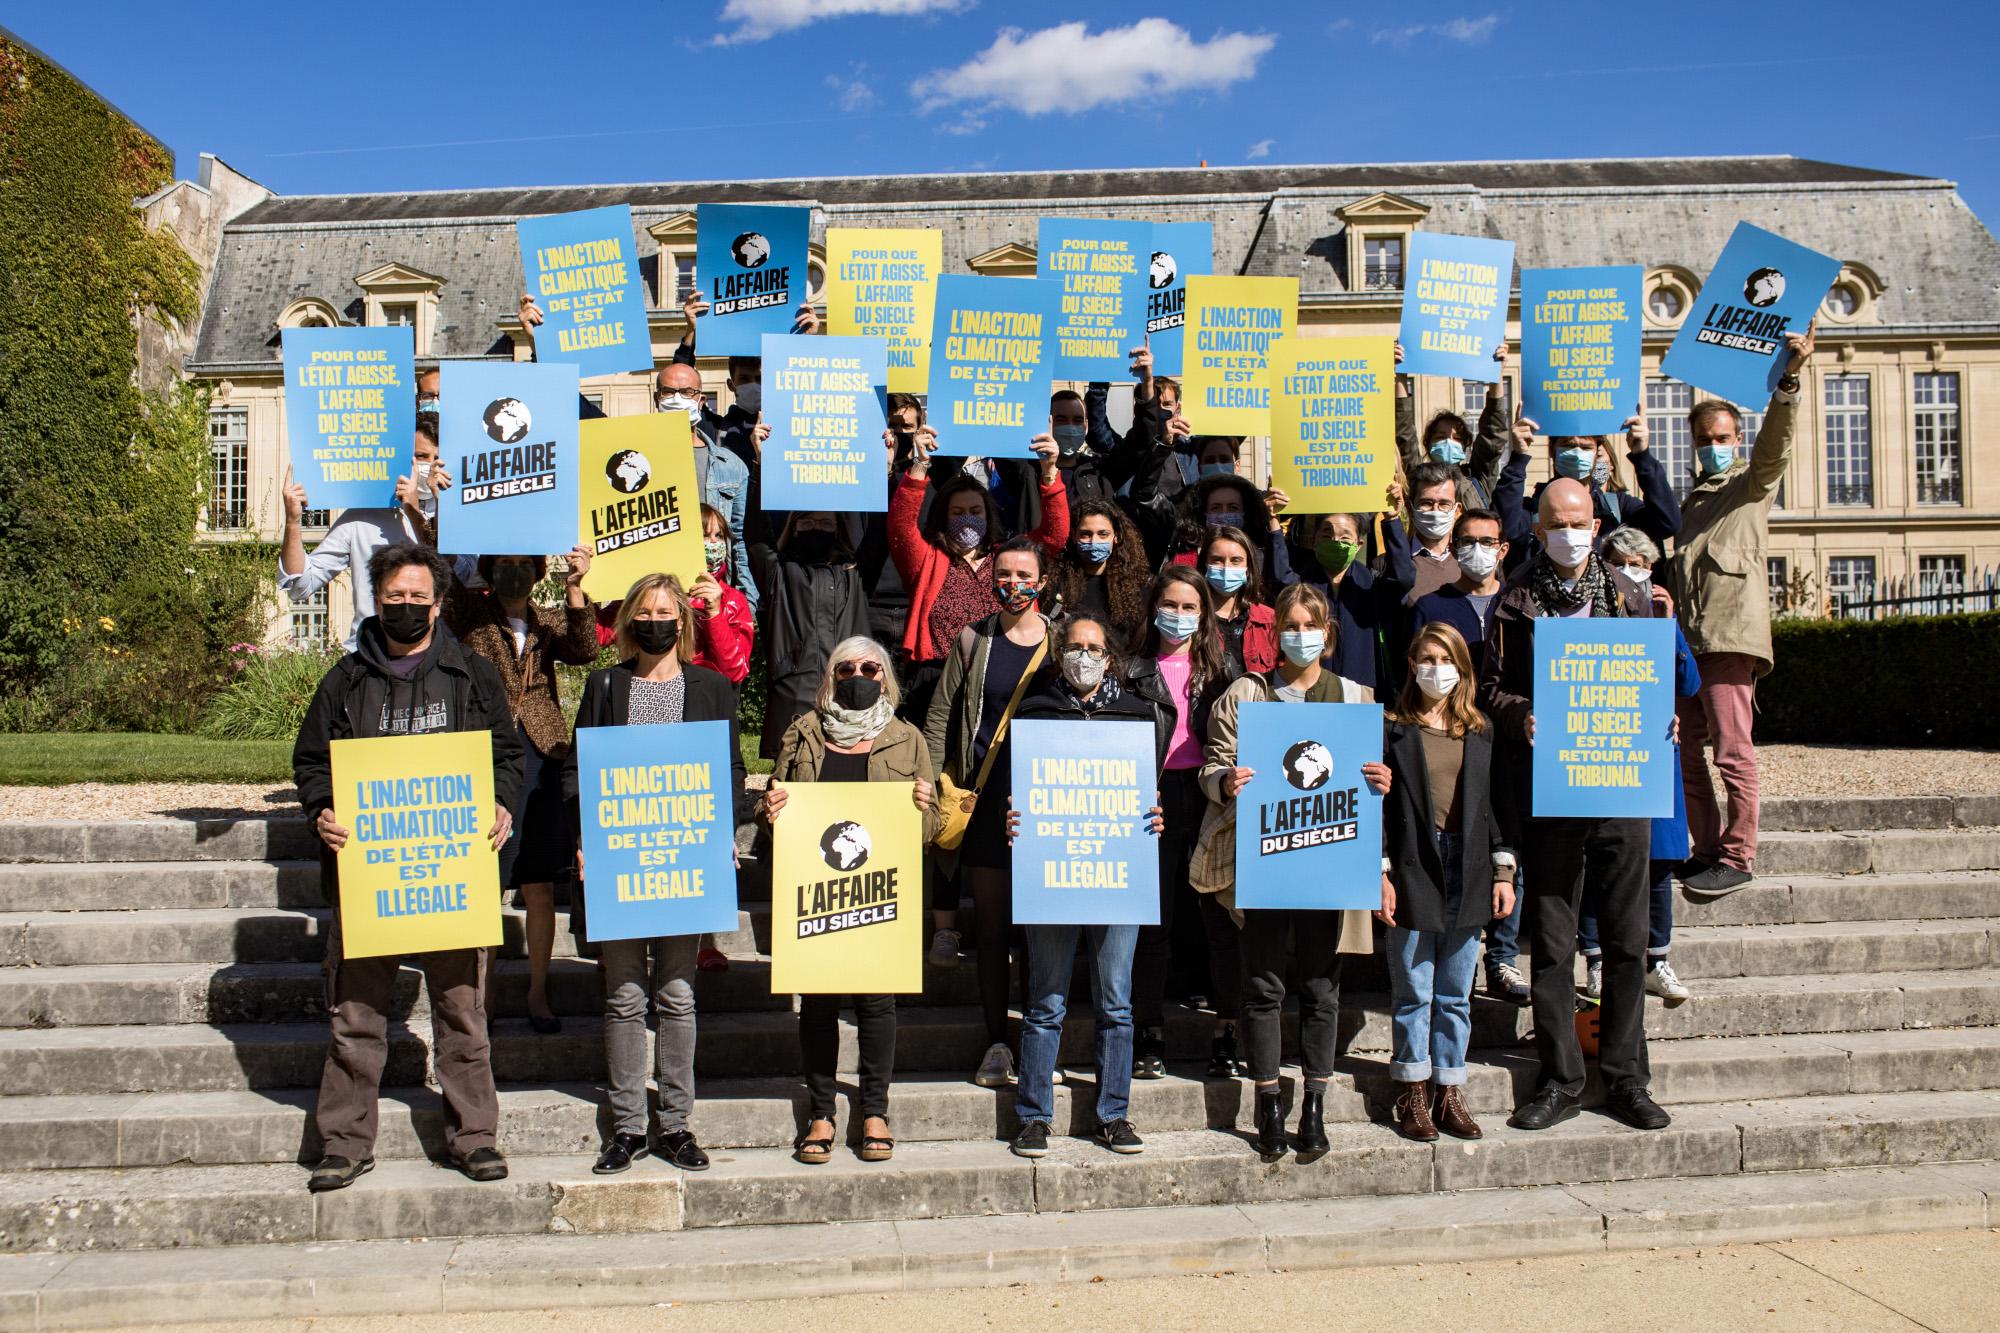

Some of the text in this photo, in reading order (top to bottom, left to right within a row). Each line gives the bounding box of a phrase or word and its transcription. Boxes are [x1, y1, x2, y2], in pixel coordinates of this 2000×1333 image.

[538, 238, 621, 271] L'INACTION
[852, 250, 917, 259] POUR QUE
[1063, 240, 1128, 251] POUR QUE
[841, 261, 928, 282] L'ÉTAT AGISSE,
[1050, 250, 1138, 275] L'ÉTAT AGISSE,
[1422, 259, 1498, 286] L'INACTION
[540, 262, 628, 296] CLIMATIQUE
[714, 266, 789, 300] L'AFFAIRE
[1065, 275, 1122, 293] L'AFFAIRE
[549, 290, 624, 312] DE L'ÉTAT
[716, 293, 786, 314] DU SIÈCLE
[856, 285, 912, 302] L'AFFAIRE
[1062, 293, 1122, 315] DU SIÈCLE
[1417, 280, 1498, 308] CLIMATIQUE
[1548, 288, 1617, 300] POUR QUE
[574, 308, 603, 323] EST
[855, 304, 914, 324] DU SIÈCLE
[1069, 316, 1113, 326] EST DE
[1147, 313, 1184, 332] SIÈCL
[1201, 307, 1281, 328] L'INACTION
[1420, 304, 1490, 320] DE L'ÉTAT
[1535, 301, 1629, 323] L'ÉTAT AGISSE,
[1704, 304, 1791, 339] L'AFFAIRE
[863, 326, 907, 335] EST DE
[951, 310, 1042, 337] L'INACTION
[1057, 327, 1127, 338] RETOUR AU
[1440, 318, 1468, 329] EST
[559, 322, 625, 352] ILLÉGALE
[904, 338, 921, 347] AU
[1421, 329, 1482, 356] ILLÉGALE
[1552, 325, 1613, 344] L'AFFAIRE
[1698, 330, 1775, 354] DU SIÈCLE
[312, 351, 387, 362] POUR QUE
[946, 336, 1042, 367] CLIMATIQUE
[1060, 339, 1120, 358] TRIBUNAL
[1550, 344, 1614, 367] DU SIÈCLE
[789, 357, 860, 368] POUR QUE
[1203, 355, 1269, 368] DE L'ÉTA
[1296, 360, 1367, 371] POUR QUE
[299, 363, 400, 387] L'ÉTAT AGISSE,
[776, 368, 872, 394] L'ÉTAT AGISSE,
[950, 364, 1033, 382] DE L'ÉTAT
[1225, 372, 1254, 381] EST
[1558, 367, 1606, 378] EST DE
[974, 383, 1007, 396] EST
[1284, 373, 1381, 395] L'ÉTAT AGISSE,
[1543, 379, 1620, 390] RETOUR AU
[319, 389, 384, 409] L'AFFAIRE
[794, 394, 856, 414] L'AFFAIRE
[1207, 384, 1270, 408] ILLÉGALE
[1549, 392, 1614, 411] TRIBUNAL
[954, 397, 1024, 426] ILLÉGALE
[1302, 397, 1364, 417] L'AFFAIRE
[318, 410, 387, 433] DU SIÈCLE
[792, 414, 858, 437] DU SIÈCLE
[1301, 418, 1366, 440] DU SIÈCLE
[328, 435, 380, 446] EST DE
[800, 439, 849, 449] EST DE
[1309, 442, 1358, 452] EST DE
[313, 448, 395, 459] RETOUR AU
[462, 441, 556, 484] L'AFFAIRE
[784, 451, 865, 462] RETOUR AU
[1294, 454, 1373, 465] RETOUR AU
[320, 462, 389, 481] TRIBUNAL
[791, 464, 858, 484] TRIBUNAL
[1301, 468, 1367, 487] TRIBUNAL
[464, 475, 553, 502] DU SIÈCLE
[592, 486, 678, 536] L'AFFAIRE
[597, 518, 679, 553] DU SIÈCLE
[1565, 644, 1646, 655] POUR QUE
[1551, 656, 1659, 685] L'ÉTAT AGISSE,
[1570, 686, 1640, 708] L'AFFAIRE
[1568, 708, 1642, 734] DU SIÈCLE
[1576, 736, 1632, 747] EST DE
[1559, 750, 1649, 762] RETOUR AU
[601, 762, 710, 796] L'INACTION
[1033, 759, 1136, 786] L'INACTION
[1566, 765, 1642, 787] TRIBUNAL
[357, 774, 472, 809] L'INACTION
[598, 794, 715, 828] CLIMATIQUE
[1030, 789, 1141, 821] CLIMATIQUE
[1261, 788, 1358, 834] L'AFFAIRE
[356, 806, 478, 842] CLIMATIQUE
[1037, 818, 1134, 837] DE L'ÉTAT
[608, 828, 708, 849] DE L'ÉTAT
[1067, 840, 1105, 855] EST
[1263, 824, 1355, 853] DU SIÈCLE
[367, 841, 471, 864] DE L'ÉTAT
[640, 848, 679, 866] EST
[400, 864, 440, 880] EST
[1045, 856, 1128, 888] ILLÉGALE
[617, 867, 704, 902] ILLÉGALE
[798, 867, 897, 917] L'AFFAIRE
[376, 882, 467, 917] ILLÉGALE
[800, 904, 895, 936] DU SIÈCLE
